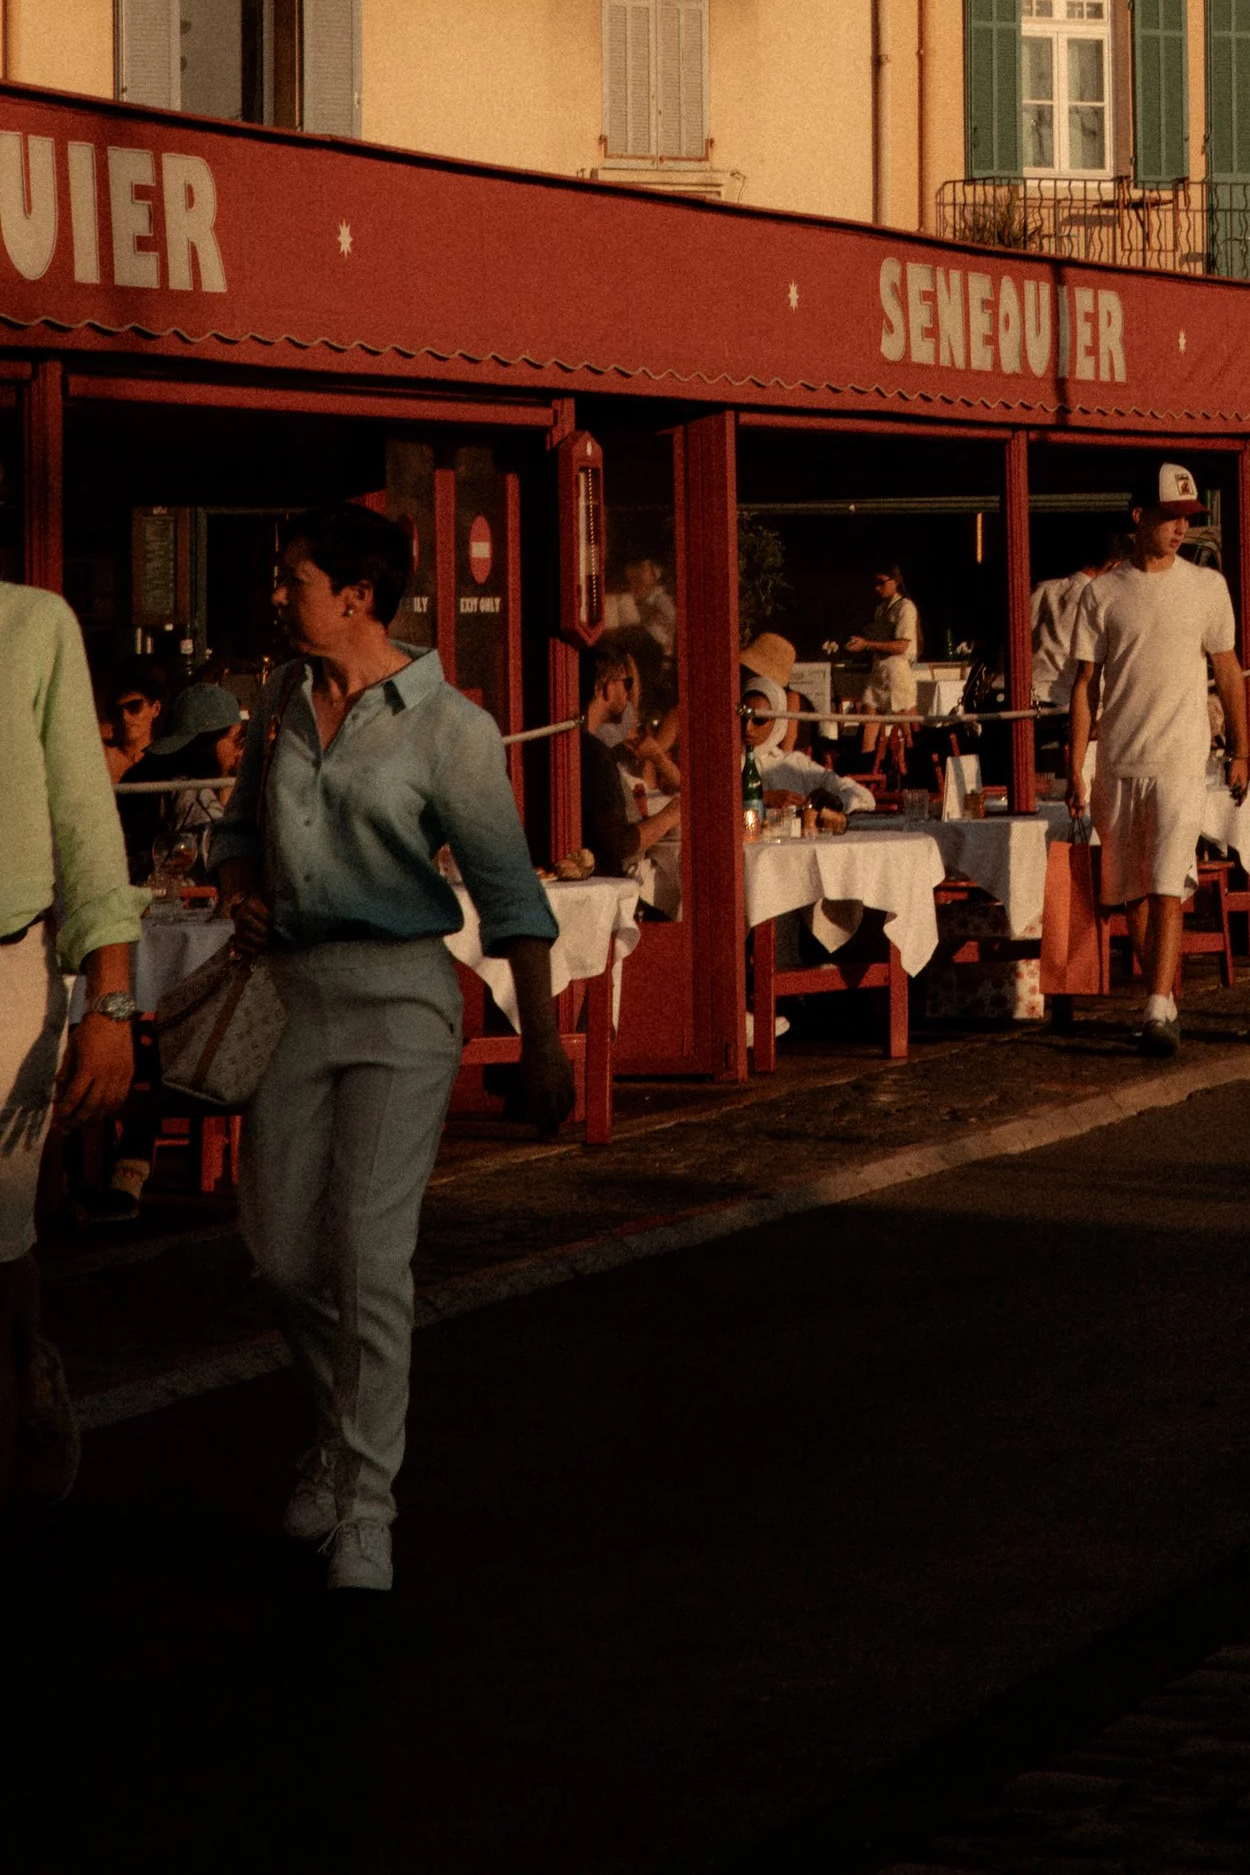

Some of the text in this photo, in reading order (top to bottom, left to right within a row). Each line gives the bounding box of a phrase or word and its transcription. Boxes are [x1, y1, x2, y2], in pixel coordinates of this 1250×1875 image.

[880, 257, 1127, 383] SENEQUIER
[459, 596, 502, 613] EXIT ONLY
